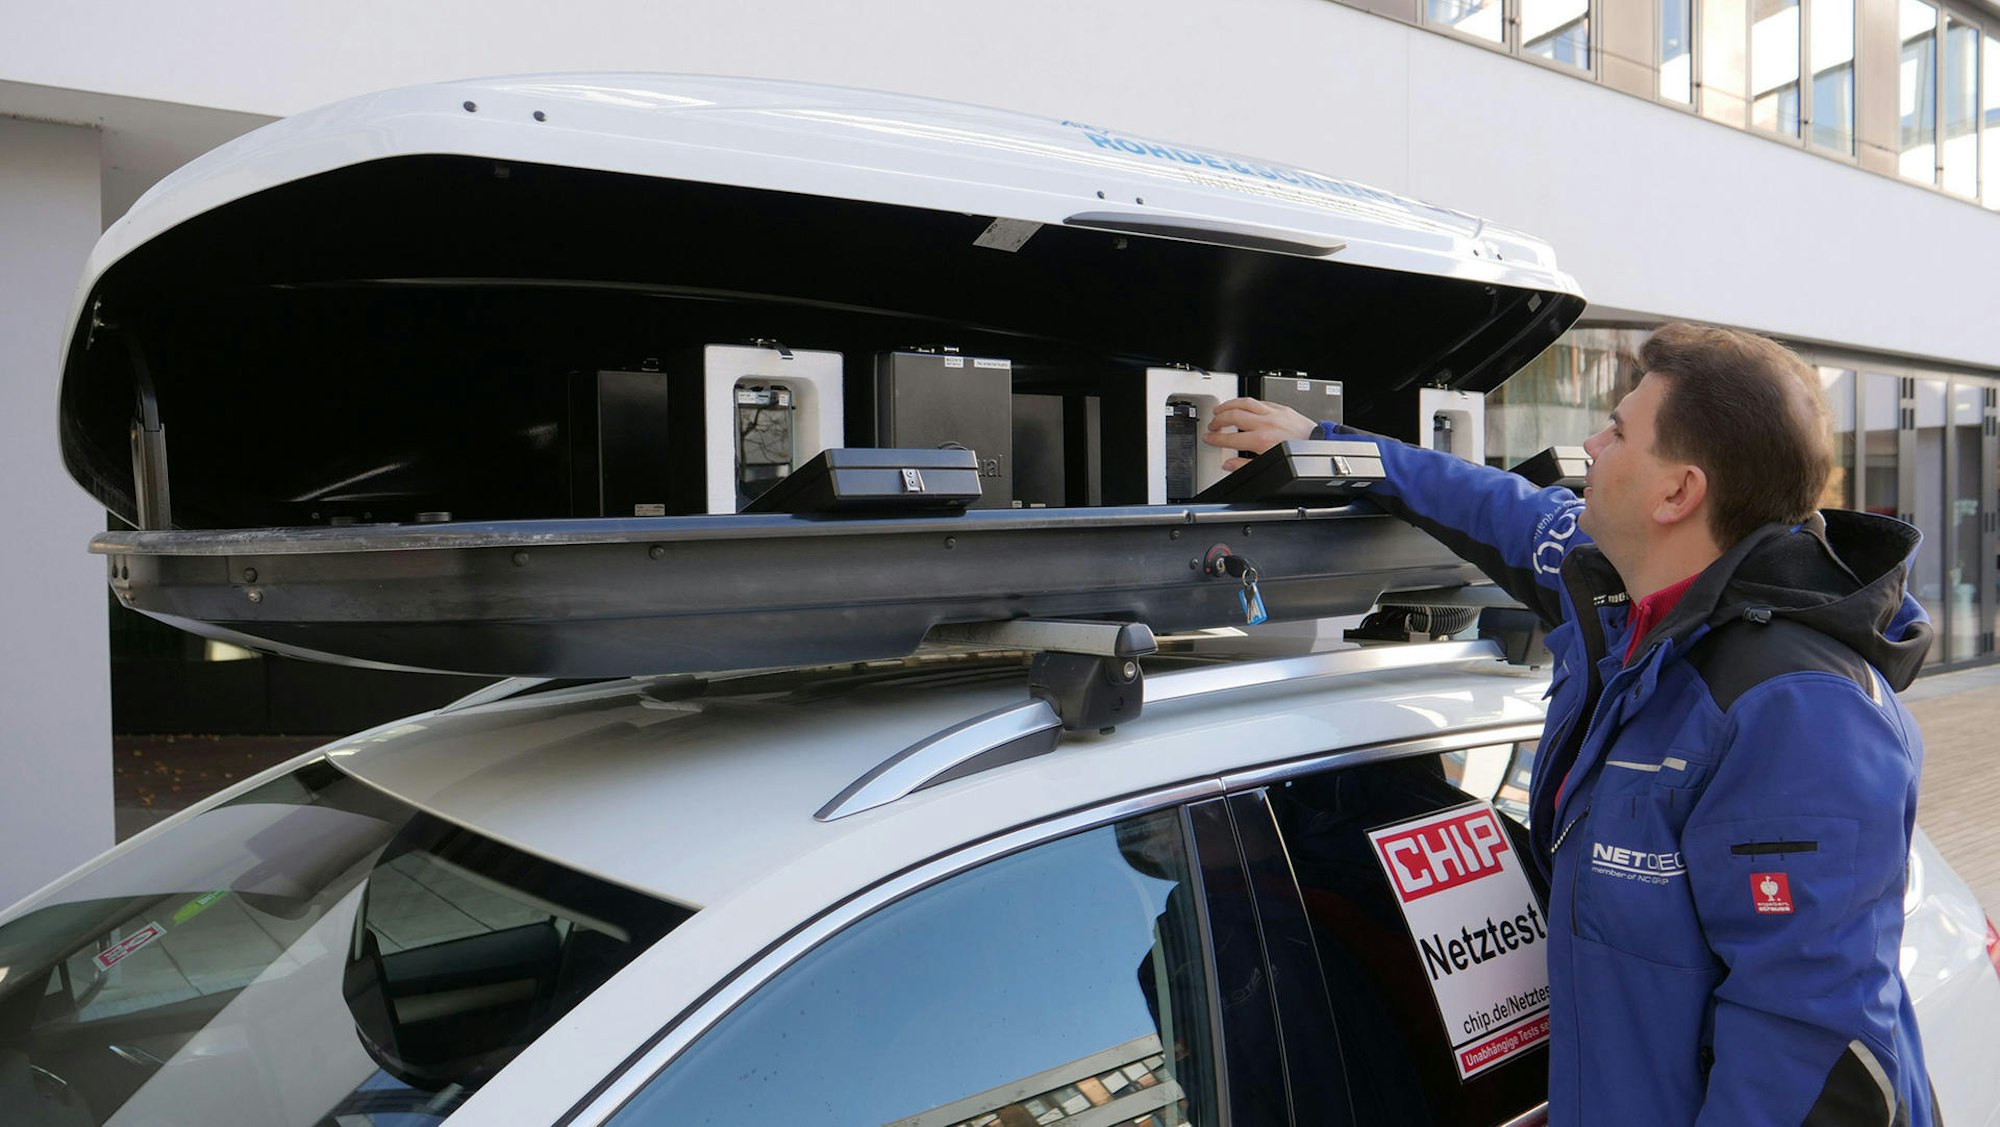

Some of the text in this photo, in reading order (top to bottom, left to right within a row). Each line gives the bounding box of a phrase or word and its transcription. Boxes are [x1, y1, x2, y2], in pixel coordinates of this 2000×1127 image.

[1384, 815, 1502, 894] CHIP
[1592, 866, 1627, 879] member
[1420, 903, 1547, 980] Netztest
[1463, 985, 1550, 1034] chip.de/Netztes
[1465, 1035, 1519, 1067] Unabhängige
[1519, 1026, 1540, 1042] Tests
